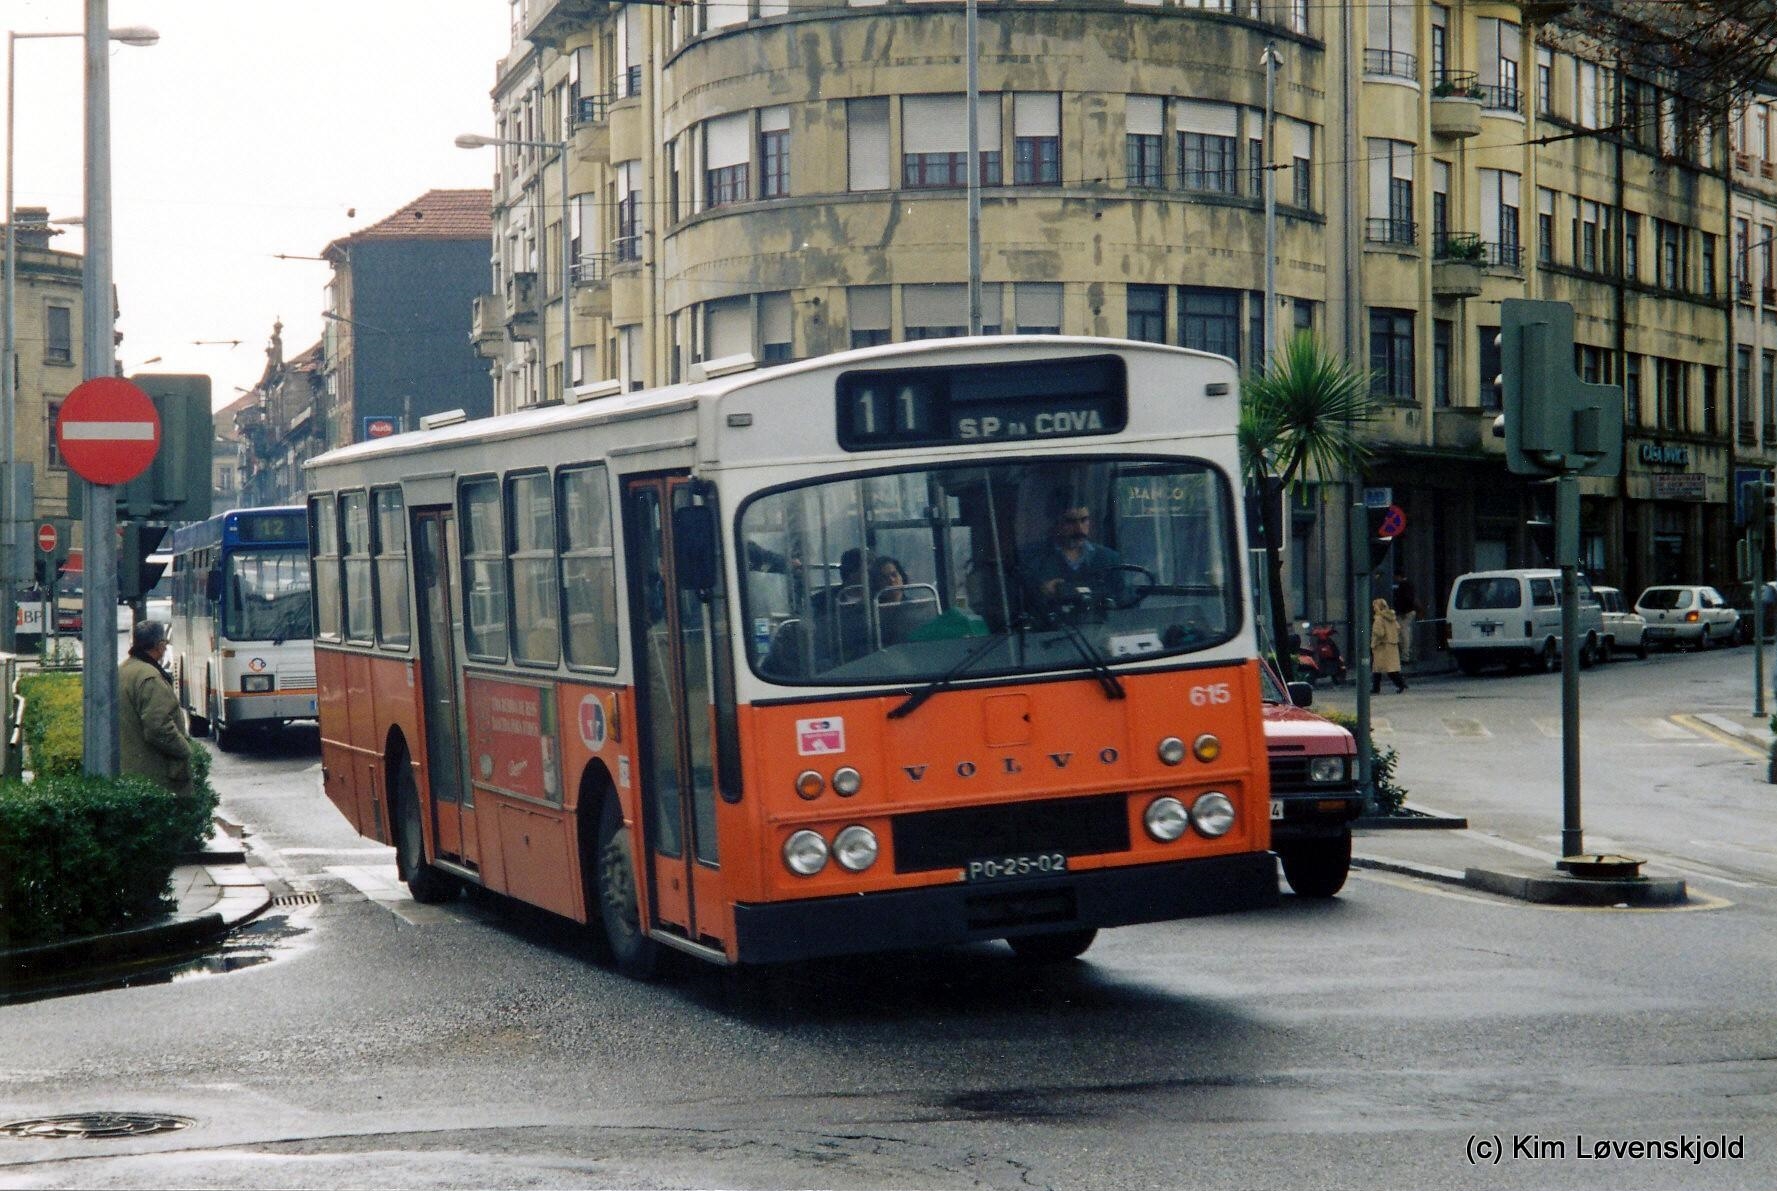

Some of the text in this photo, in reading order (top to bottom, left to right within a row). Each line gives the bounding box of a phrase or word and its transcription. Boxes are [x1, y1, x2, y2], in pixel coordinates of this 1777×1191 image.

[1035, 410, 1103, 433] COVA
[262, 520, 285, 536] 12
[1190, 683, 1231, 706] 615
[902, 748, 1119, 782] VOLVO
